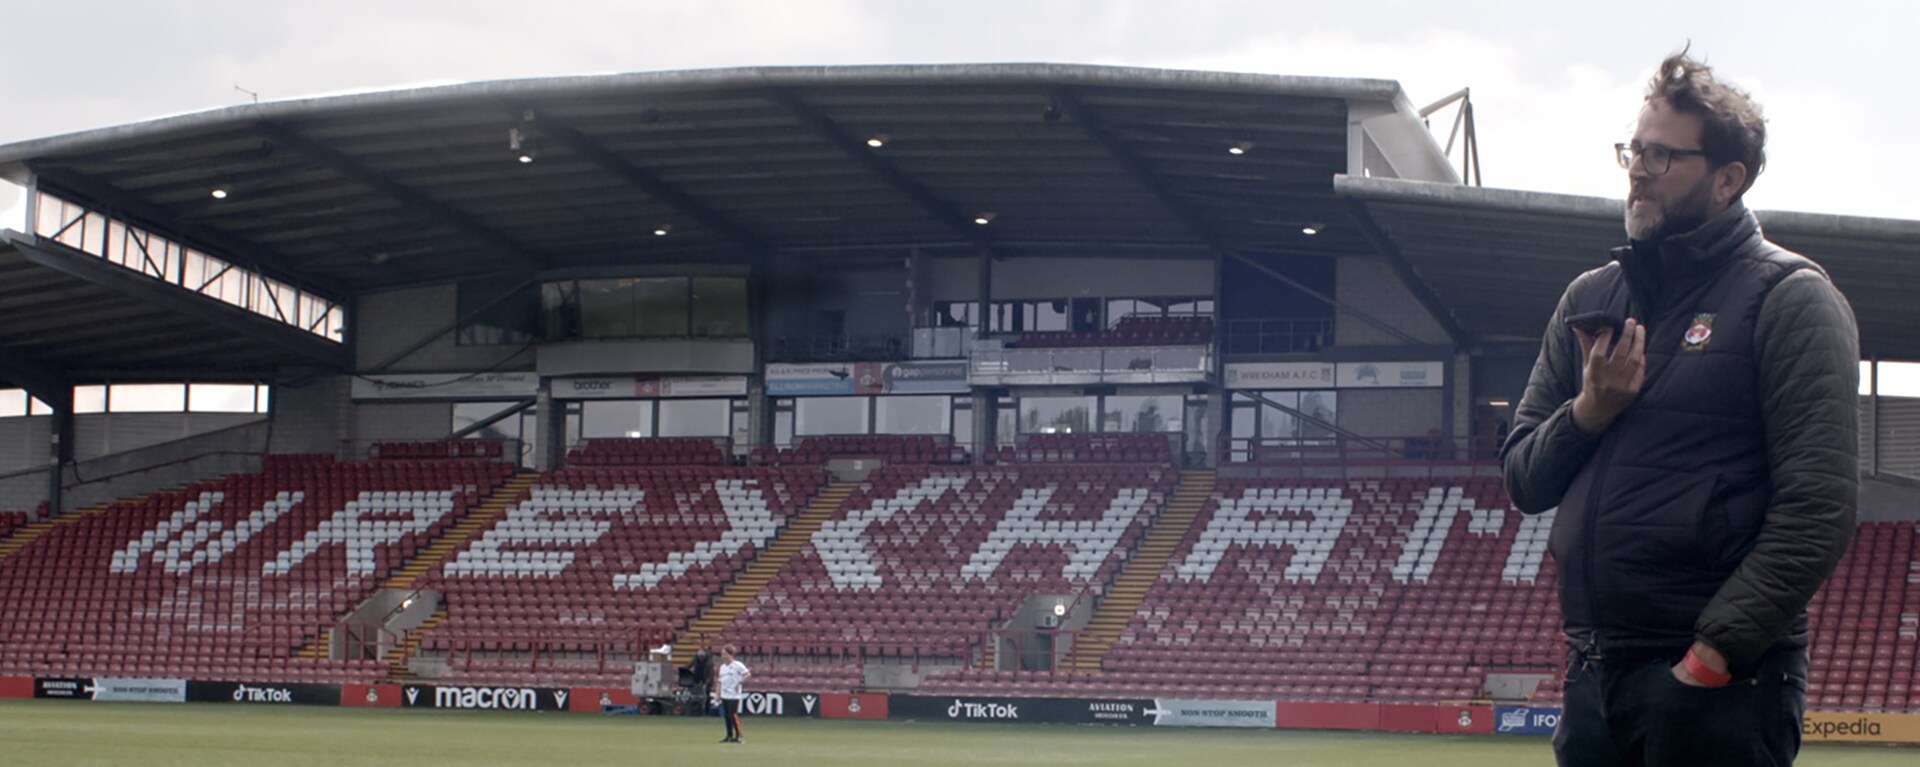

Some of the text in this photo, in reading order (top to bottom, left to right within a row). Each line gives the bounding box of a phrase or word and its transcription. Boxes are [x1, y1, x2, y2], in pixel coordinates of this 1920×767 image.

[247, 686, 292, 702] TikTok
[435, 686, 537, 709] macron
[737, 692, 783, 715] ron
[963, 702, 1018, 719] TikTok
[1088, 702, 1134, 713] AVIATION
[1227, 709, 1268, 719] SMOOTH
[1801, 717, 1881, 738] Expedia
